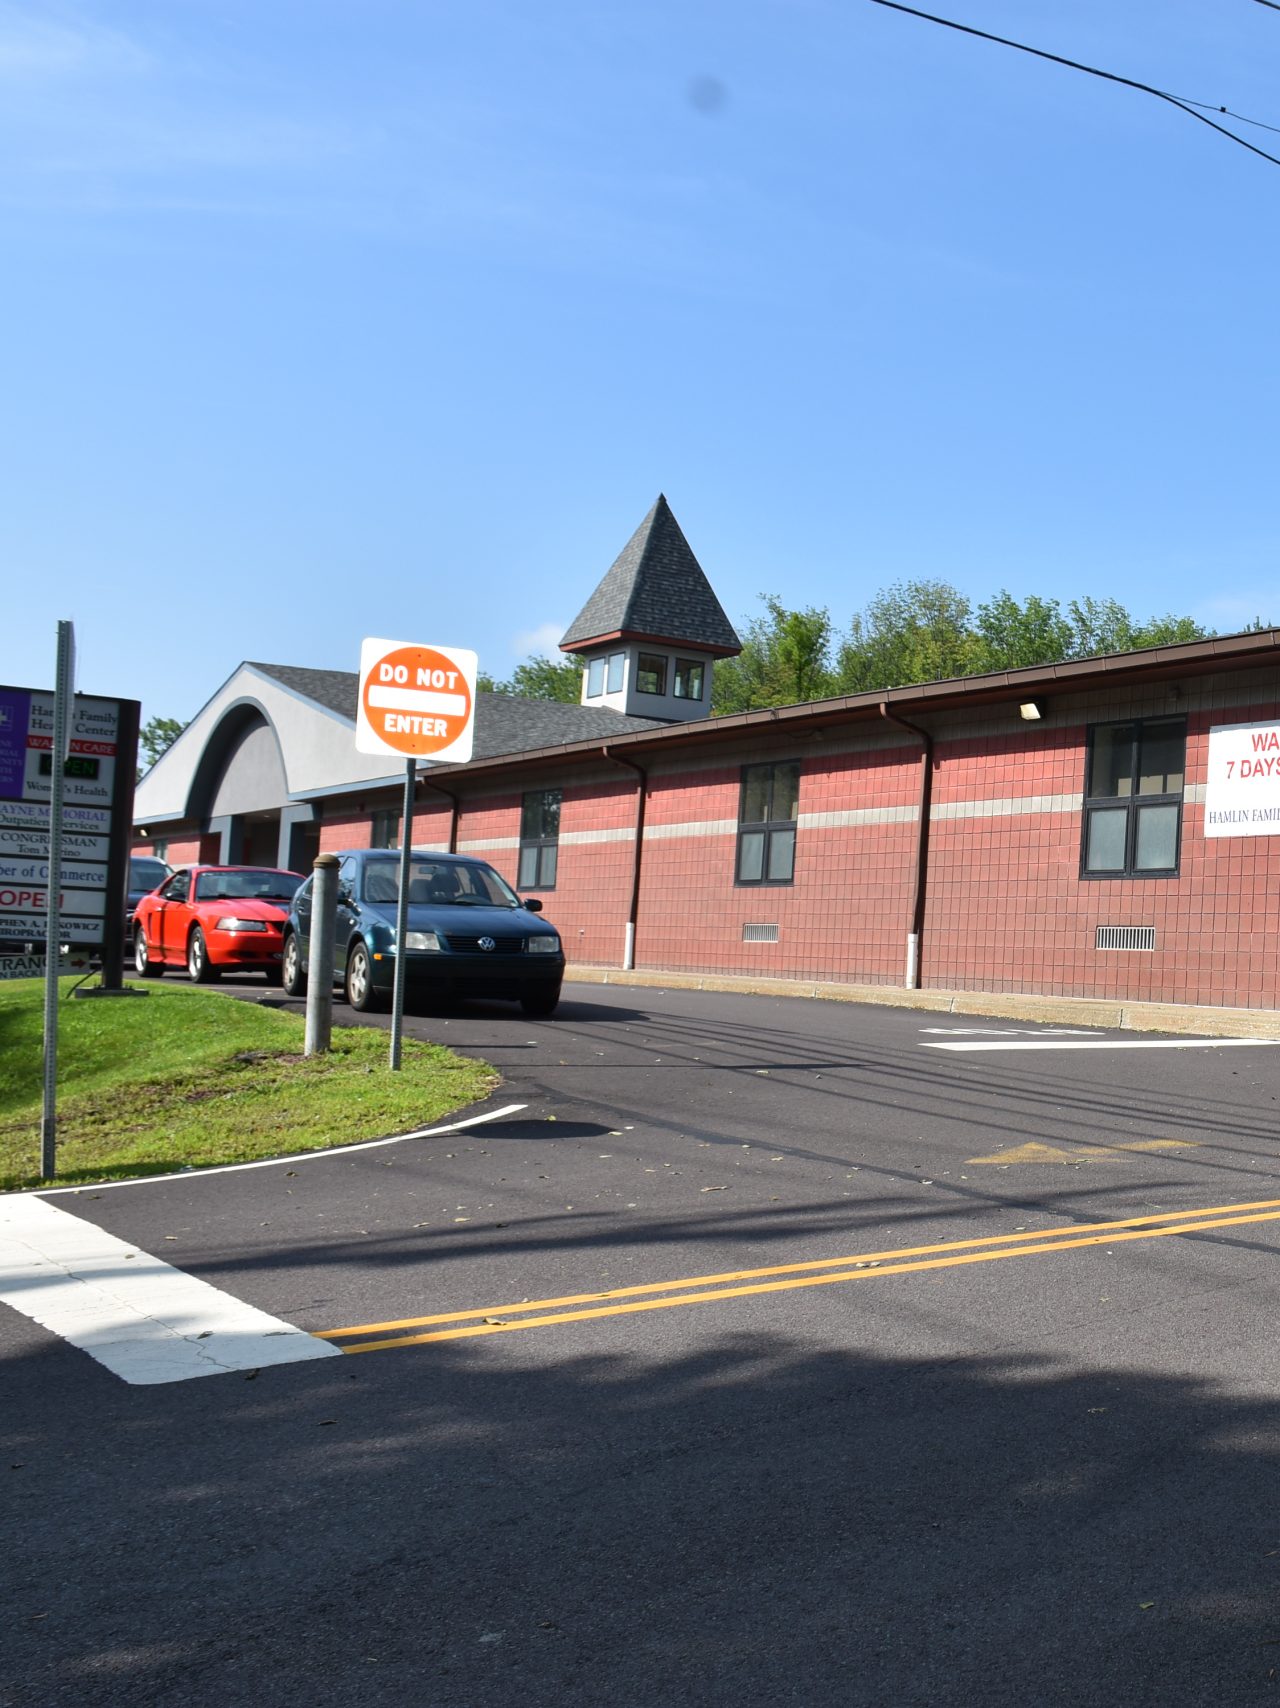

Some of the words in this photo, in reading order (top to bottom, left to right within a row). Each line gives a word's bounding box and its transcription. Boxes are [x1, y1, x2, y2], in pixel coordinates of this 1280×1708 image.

[380, 664, 408, 683] DO
[417, 668, 458, 689] NOT
[80, 710, 116, 724] Family
[75, 723, 116, 736] Center
[384, 713, 448, 737] ENTER
[82, 744, 115, 754] CARE
[1226, 761, 1235, 779] 7
[26, 781, 71, 793] Wom's
[74, 785, 108, 797] Health
[38, 807, 107, 820] MORIAL
[1209, 810, 1250, 824] HAMLIN
[0, 814, 50, 827] Outpatien
[61, 821, 100, 830] ervices
[1, 832, 97, 847] CONGRSMAN
[17, 844, 40, 854] Tom
[43, 846, 81, 856] Mrino
[21, 865, 36, 877] of
[39, 865, 105, 881] Cmmerce
